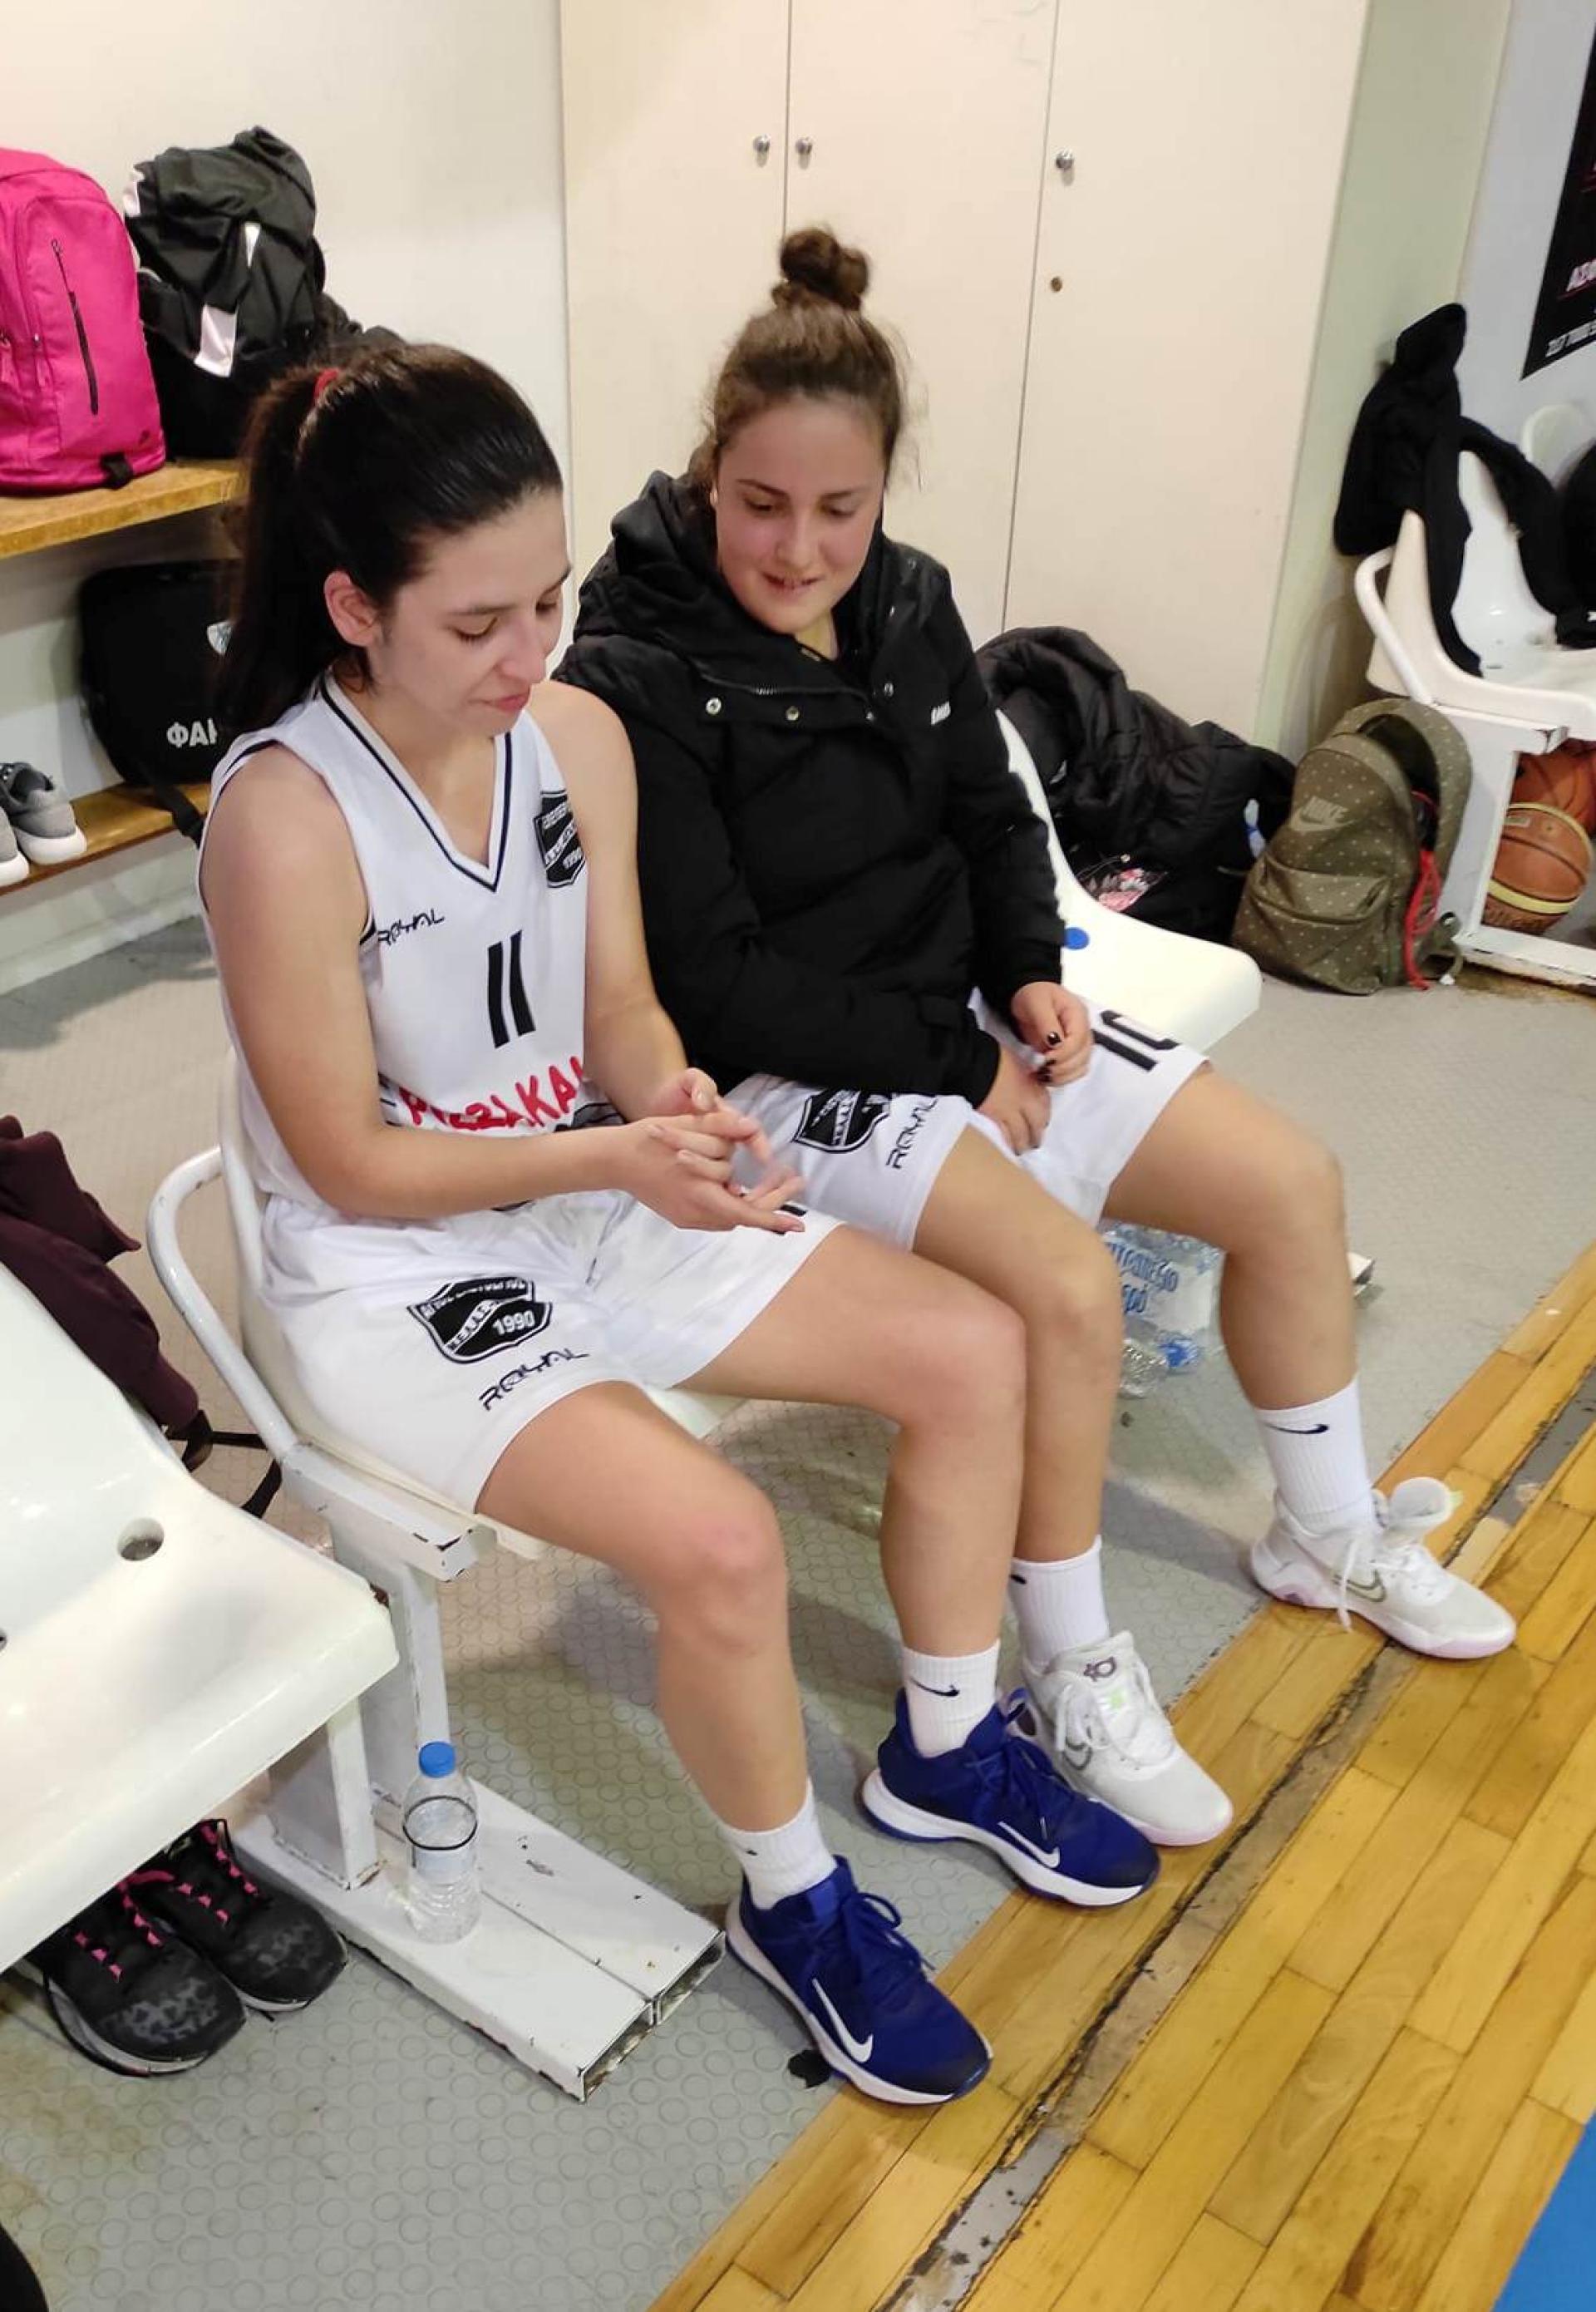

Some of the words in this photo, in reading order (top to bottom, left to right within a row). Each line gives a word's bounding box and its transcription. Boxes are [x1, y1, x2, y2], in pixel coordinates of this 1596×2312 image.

[486, 929, 536, 1049] 11
[491, 1309, 535, 1337] 1990
[479, 1348, 591, 1412] ROYAL
